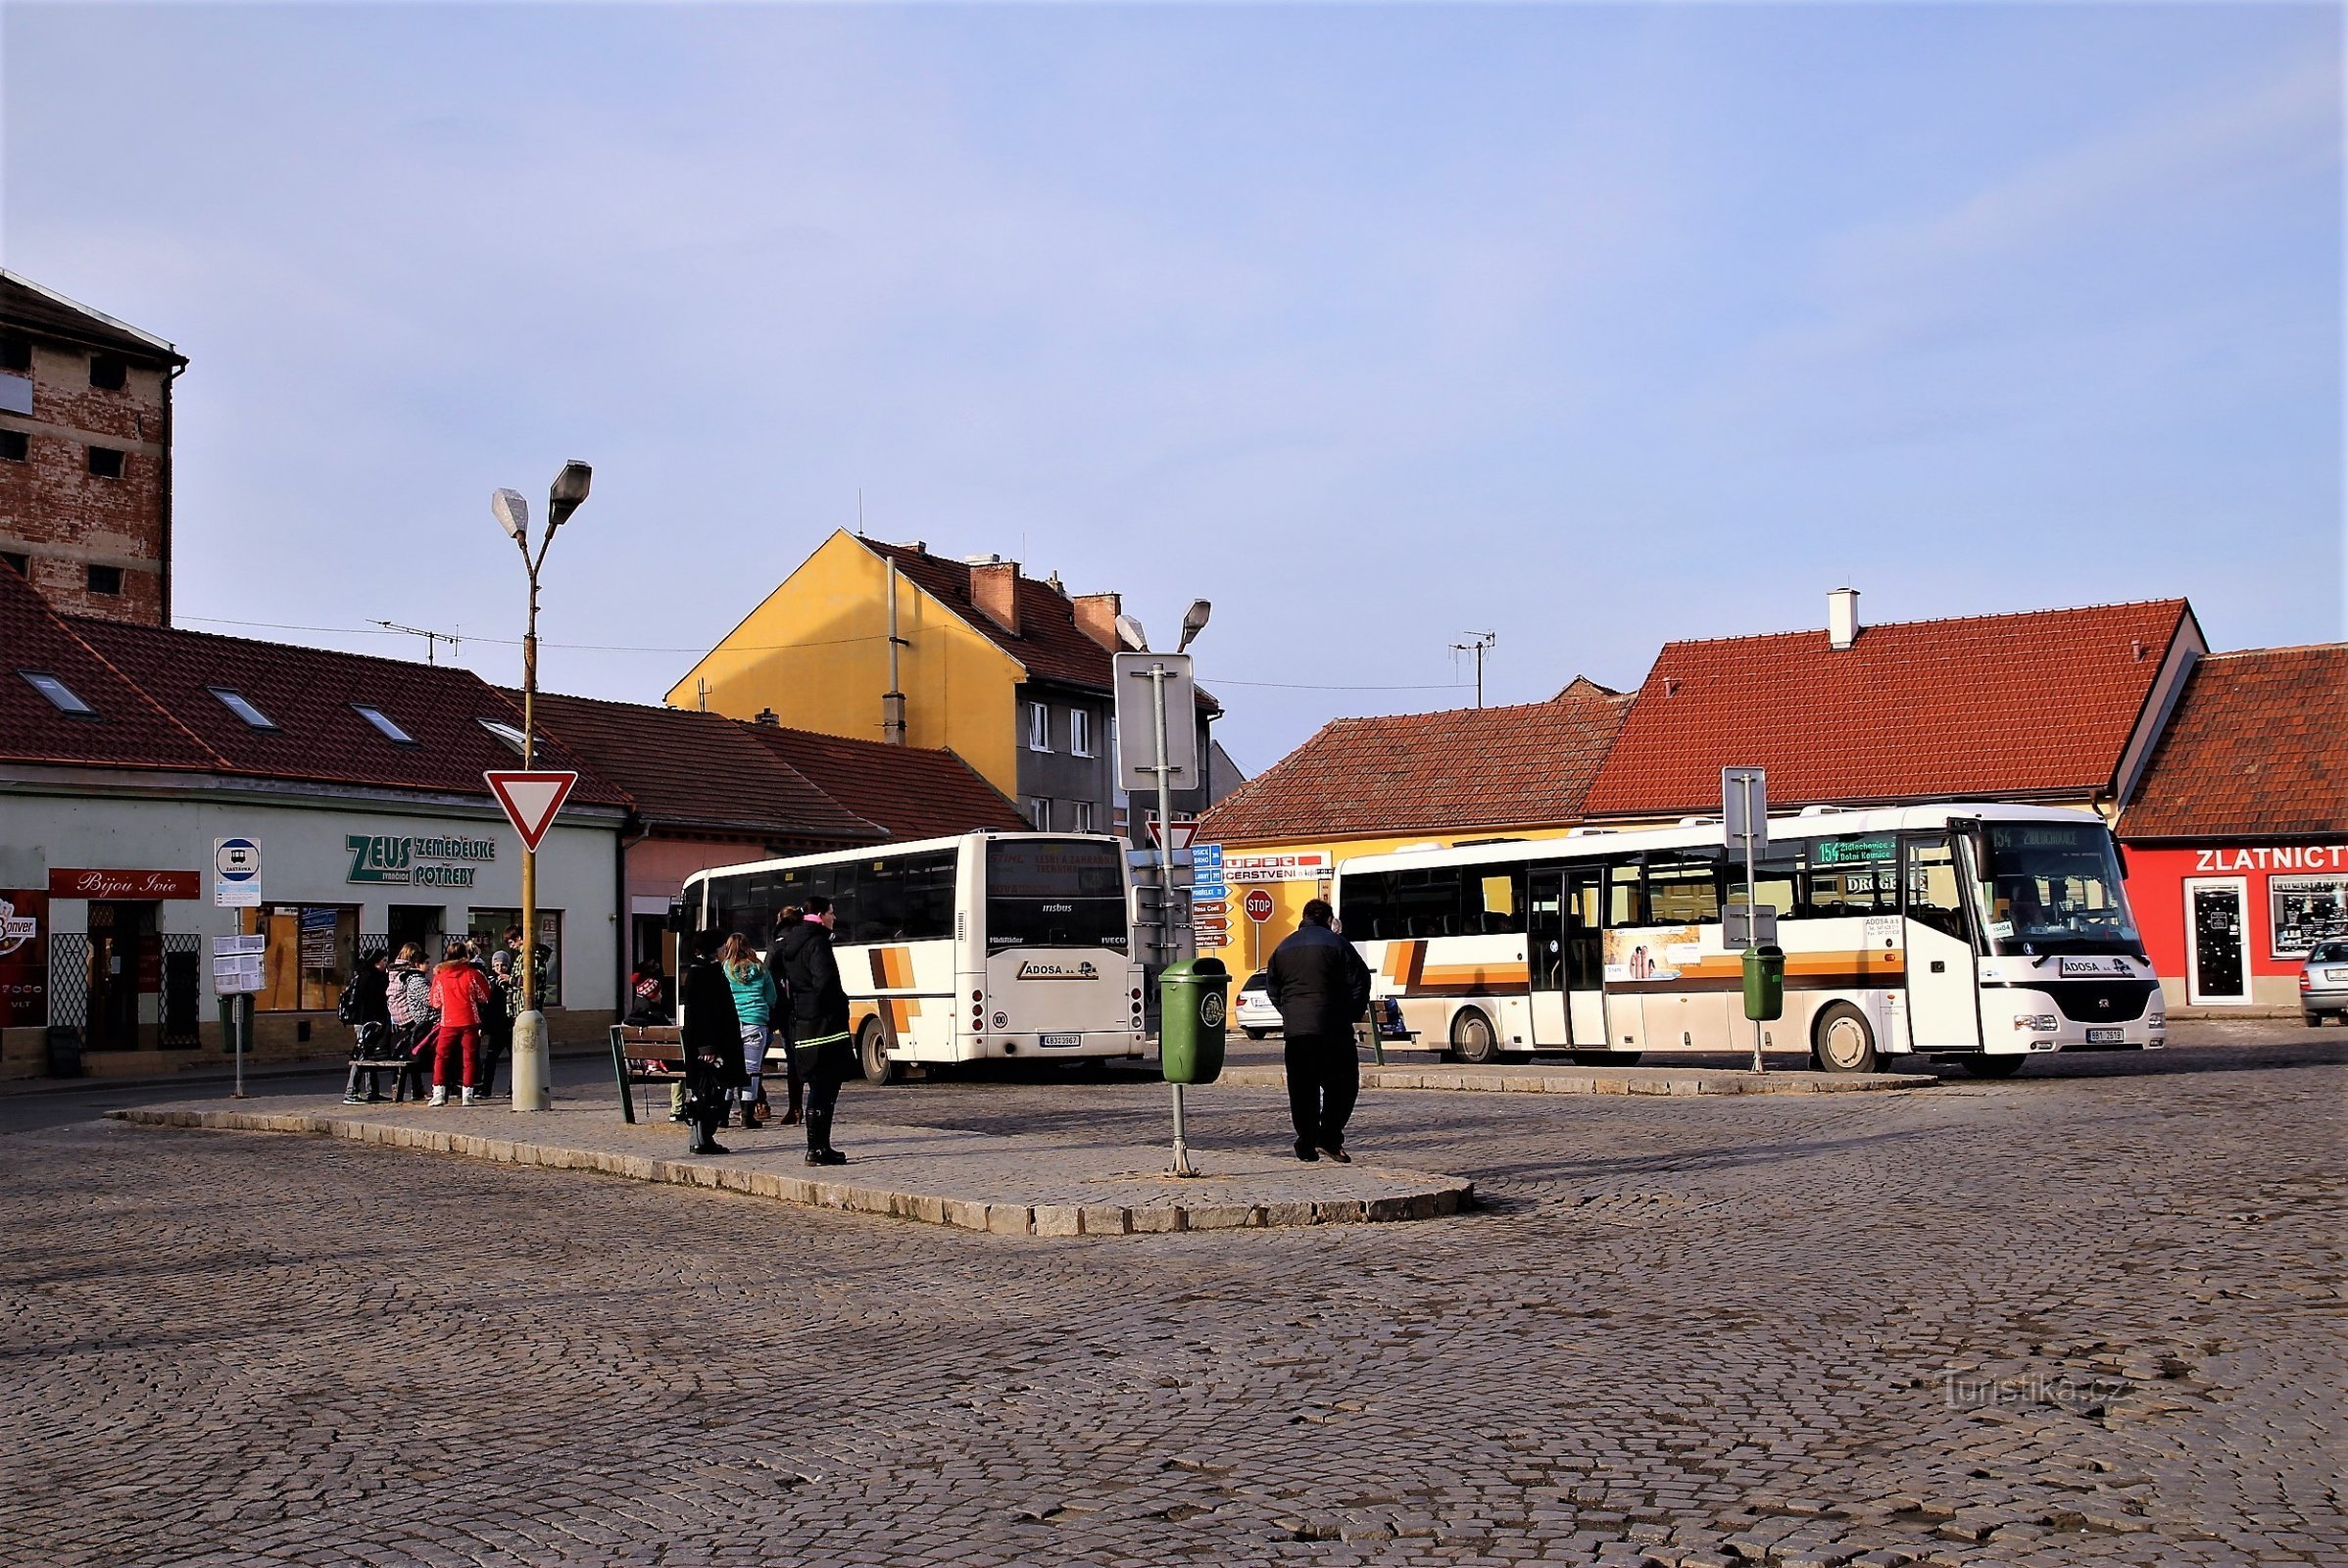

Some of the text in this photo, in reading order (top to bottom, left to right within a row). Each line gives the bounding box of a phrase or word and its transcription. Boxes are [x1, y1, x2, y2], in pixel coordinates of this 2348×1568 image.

[347, 834, 412, 883] ZEUS
[1819, 843, 1839, 862] 154
[2196, 846, 2348, 871] ZLATNICT
[414, 861, 477, 887] POTŘEBY
[76, 871, 132, 898] Bijou
[1247, 900, 1271, 912] STOP
[1025, 965, 1062, 974] ADOSA
[2064, 962, 2100, 972] ADOSA
[995, 1015, 1005, 1024] 100
